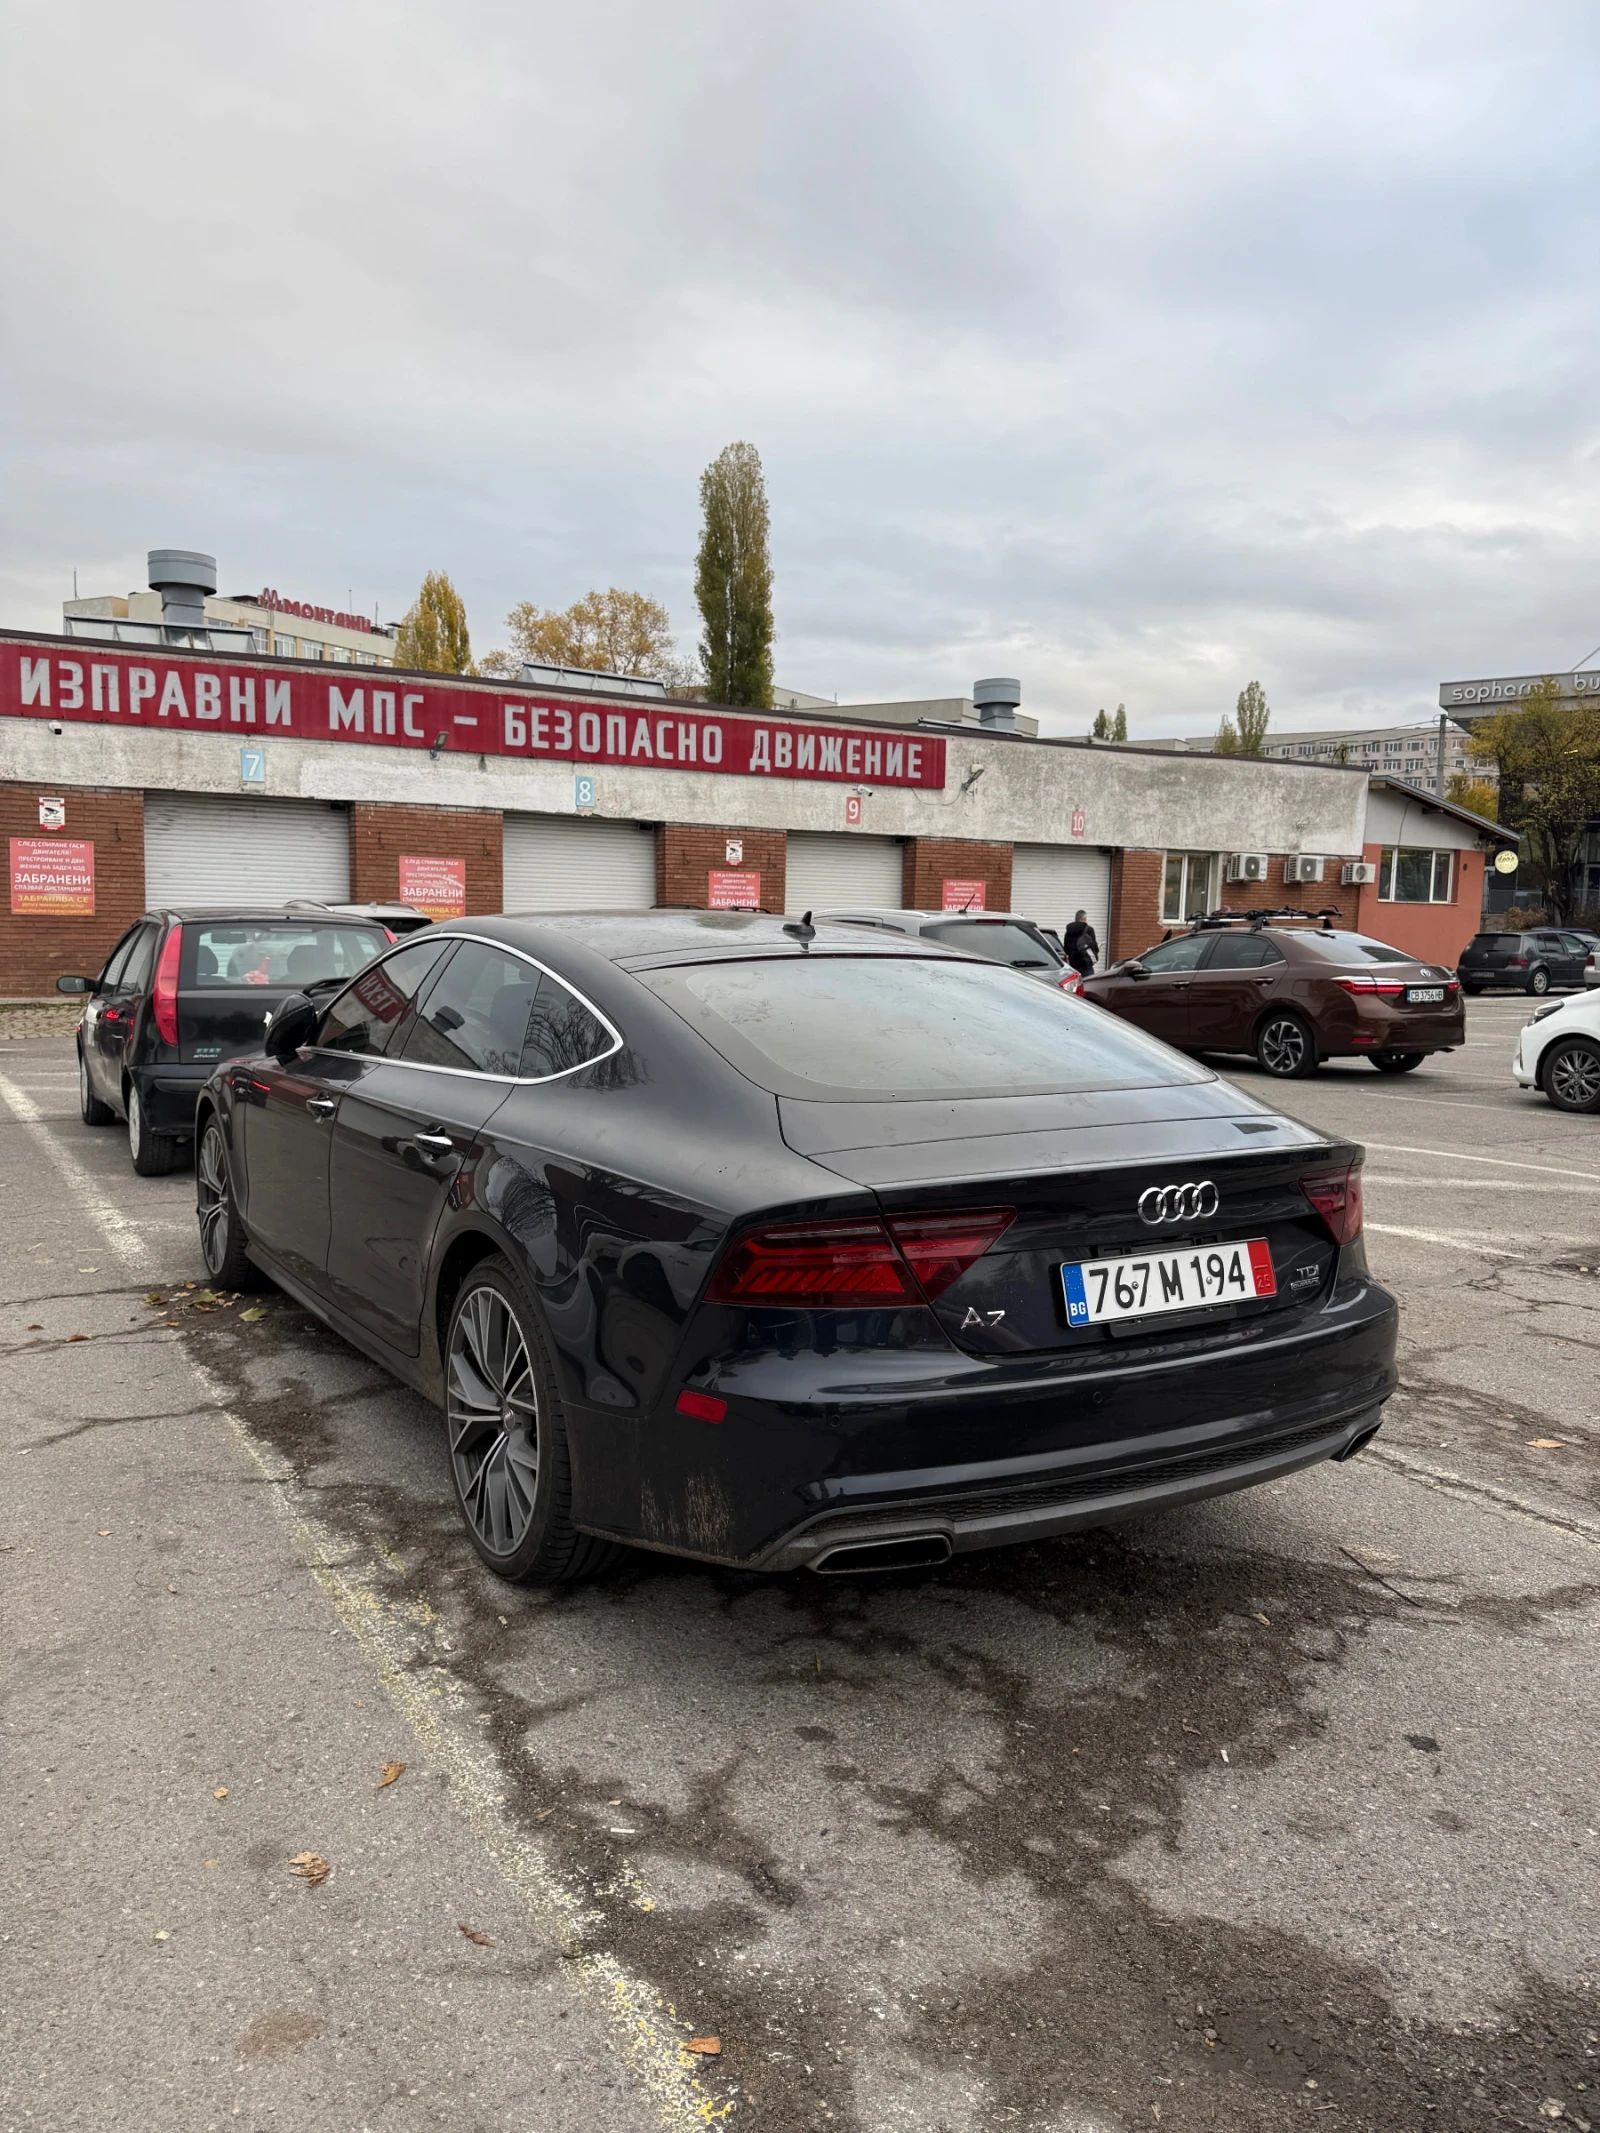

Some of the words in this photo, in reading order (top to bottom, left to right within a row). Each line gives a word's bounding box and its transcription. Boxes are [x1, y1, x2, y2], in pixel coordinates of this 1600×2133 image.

[20, 656, 292, 726] ИЗПРАВНИ
[329, 686, 425, 738] МПС
[505, 704, 723, 764] БЕЗОПАСНО
[750, 729, 922, 779] ДВИЖЕНИЕ
[245, 754, 260, 777] 7
[579, 781, 591, 802] 8
[848, 801, 859, 820] 9
[1073, 815, 1084, 831] 10
[14, 873, 91, 885] ЗАБРАНЕНИ
[17, 894, 74, 903] ЗАБРАНЯВА
[402, 887, 463, 898] ЗАБРАНЕНИ
[711, 898, 759, 907] ЗАБРАНЕНИ
[1296, 1264, 1320, 1279] TDI
[1088, 1262, 1150, 1314] 767
[1158, 1258, 1184, 1303] M
[1190, 1251, 1246, 1298] 194
[1256, 1273, 1271, 1289] 25
[1069, 1302, 1087, 1317] BG
[961, 1306, 1005, 1330] A7
